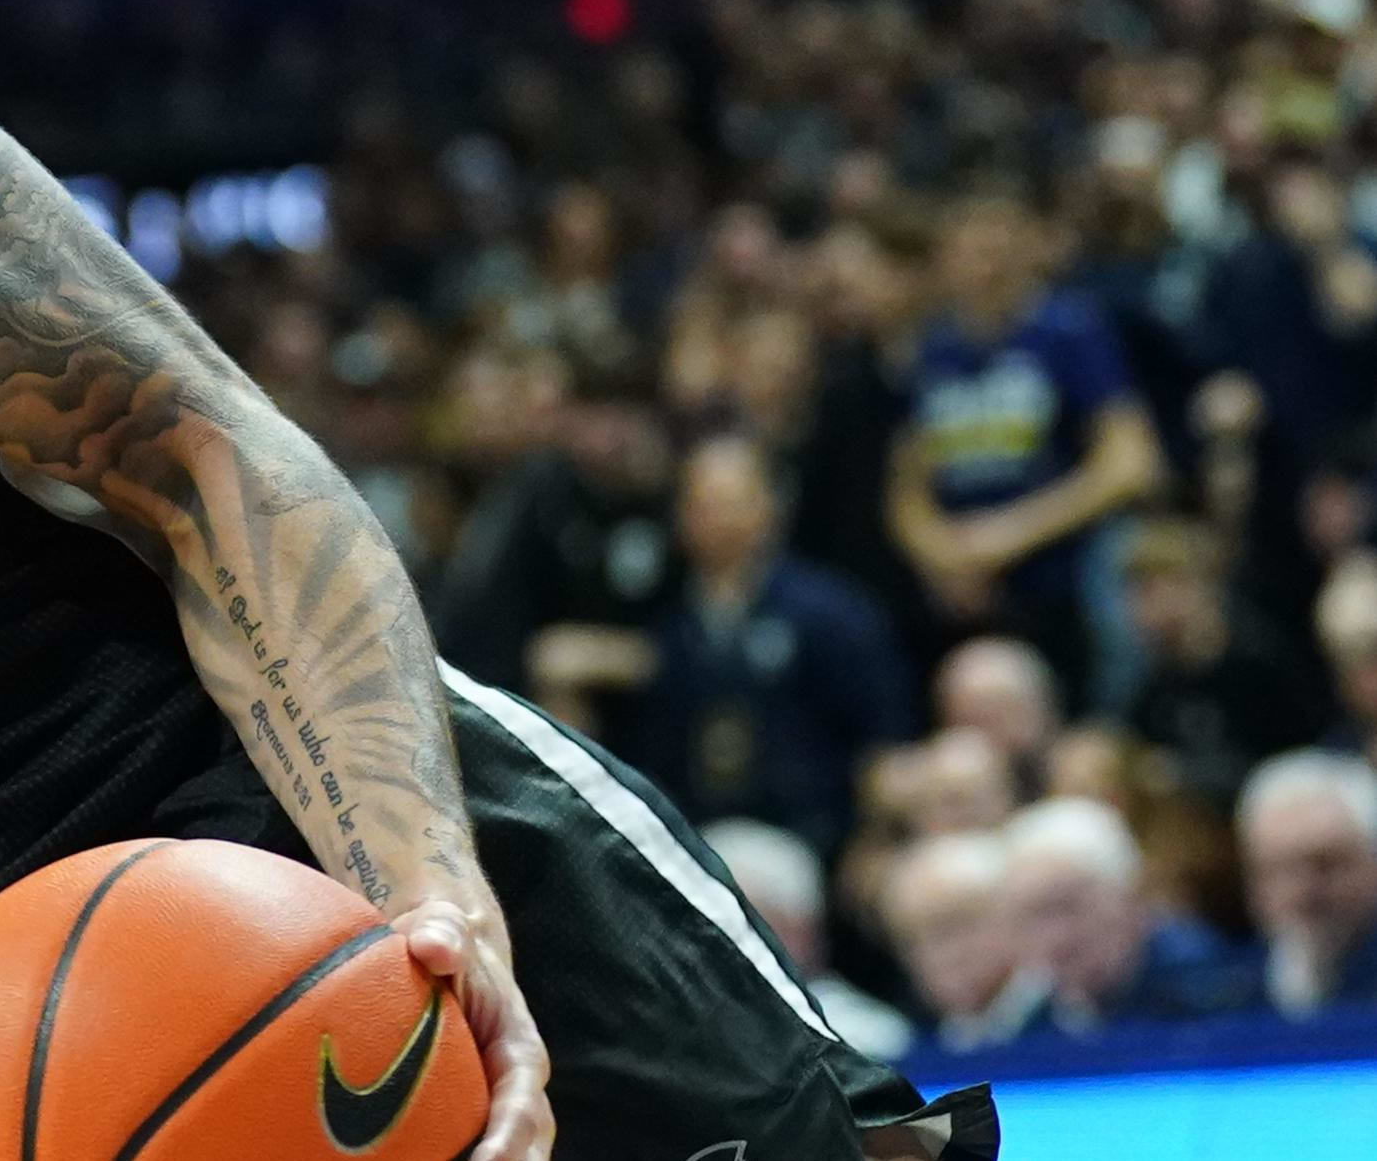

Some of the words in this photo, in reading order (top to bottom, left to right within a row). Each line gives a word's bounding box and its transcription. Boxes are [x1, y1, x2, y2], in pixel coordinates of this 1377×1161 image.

[229, 595, 262, 641] God
[254, 639, 267, 660] is
[258, 659, 288, 690] for
[283, 695, 302, 722] us
[298, 720, 331, 767] who
[320, 771, 342, 809] can
[337, 803, 359, 836] be
